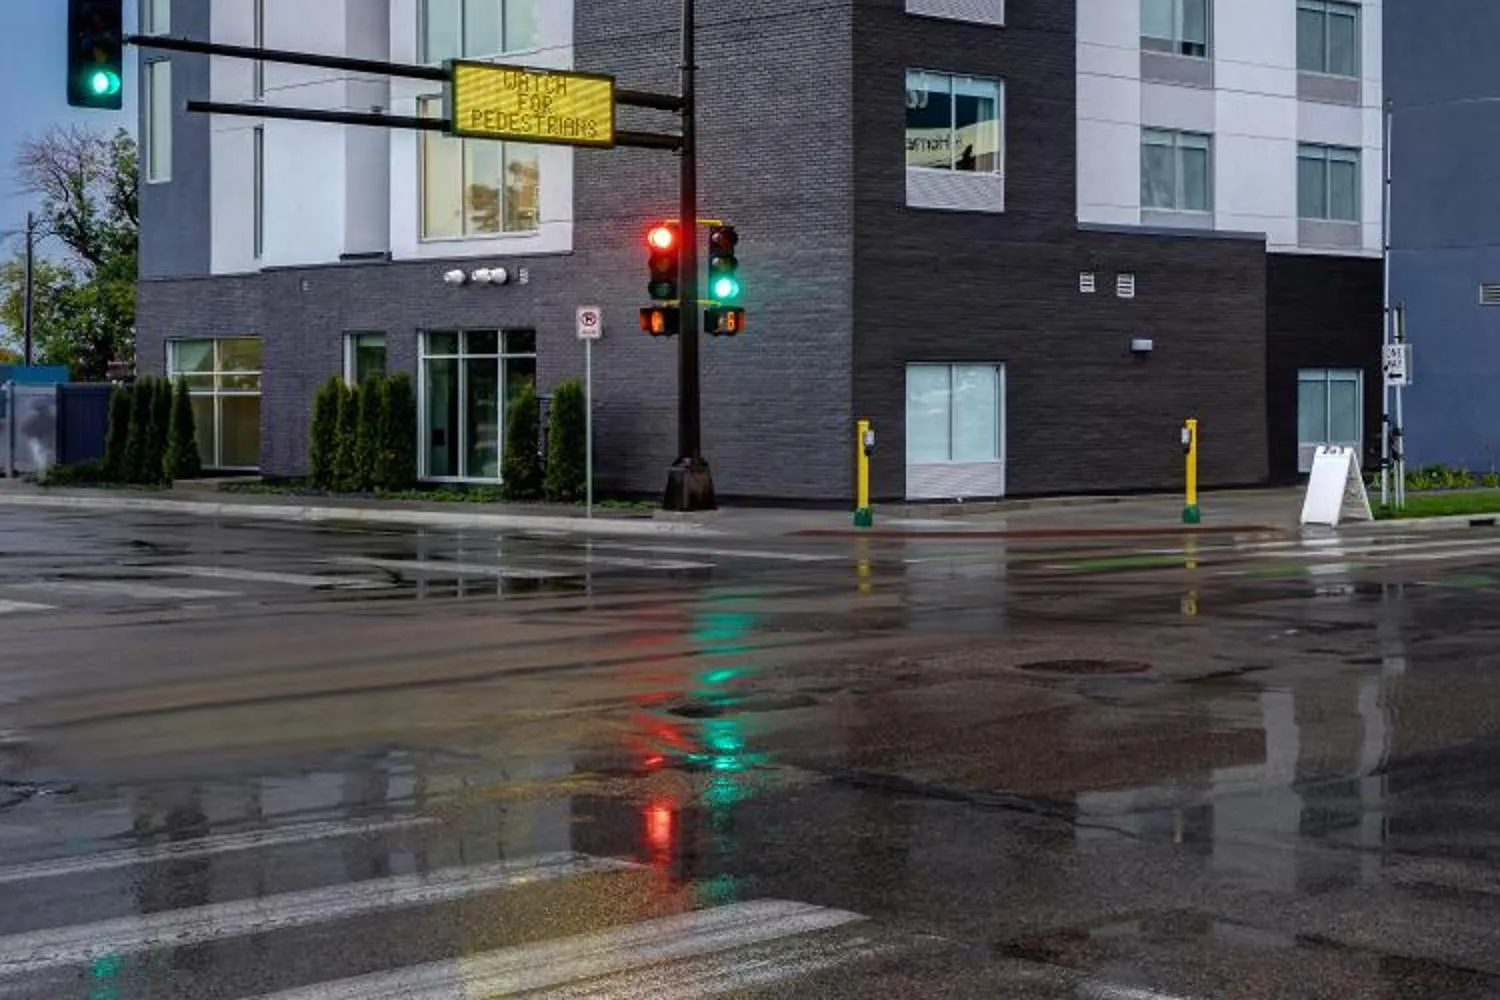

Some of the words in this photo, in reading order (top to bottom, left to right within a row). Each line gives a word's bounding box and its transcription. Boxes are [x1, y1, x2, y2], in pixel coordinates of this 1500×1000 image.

[504, 71, 568, 95] WATCH
[517, 93, 554, 113] FOR
[471, 109, 599, 138] PEDESTRIANS
